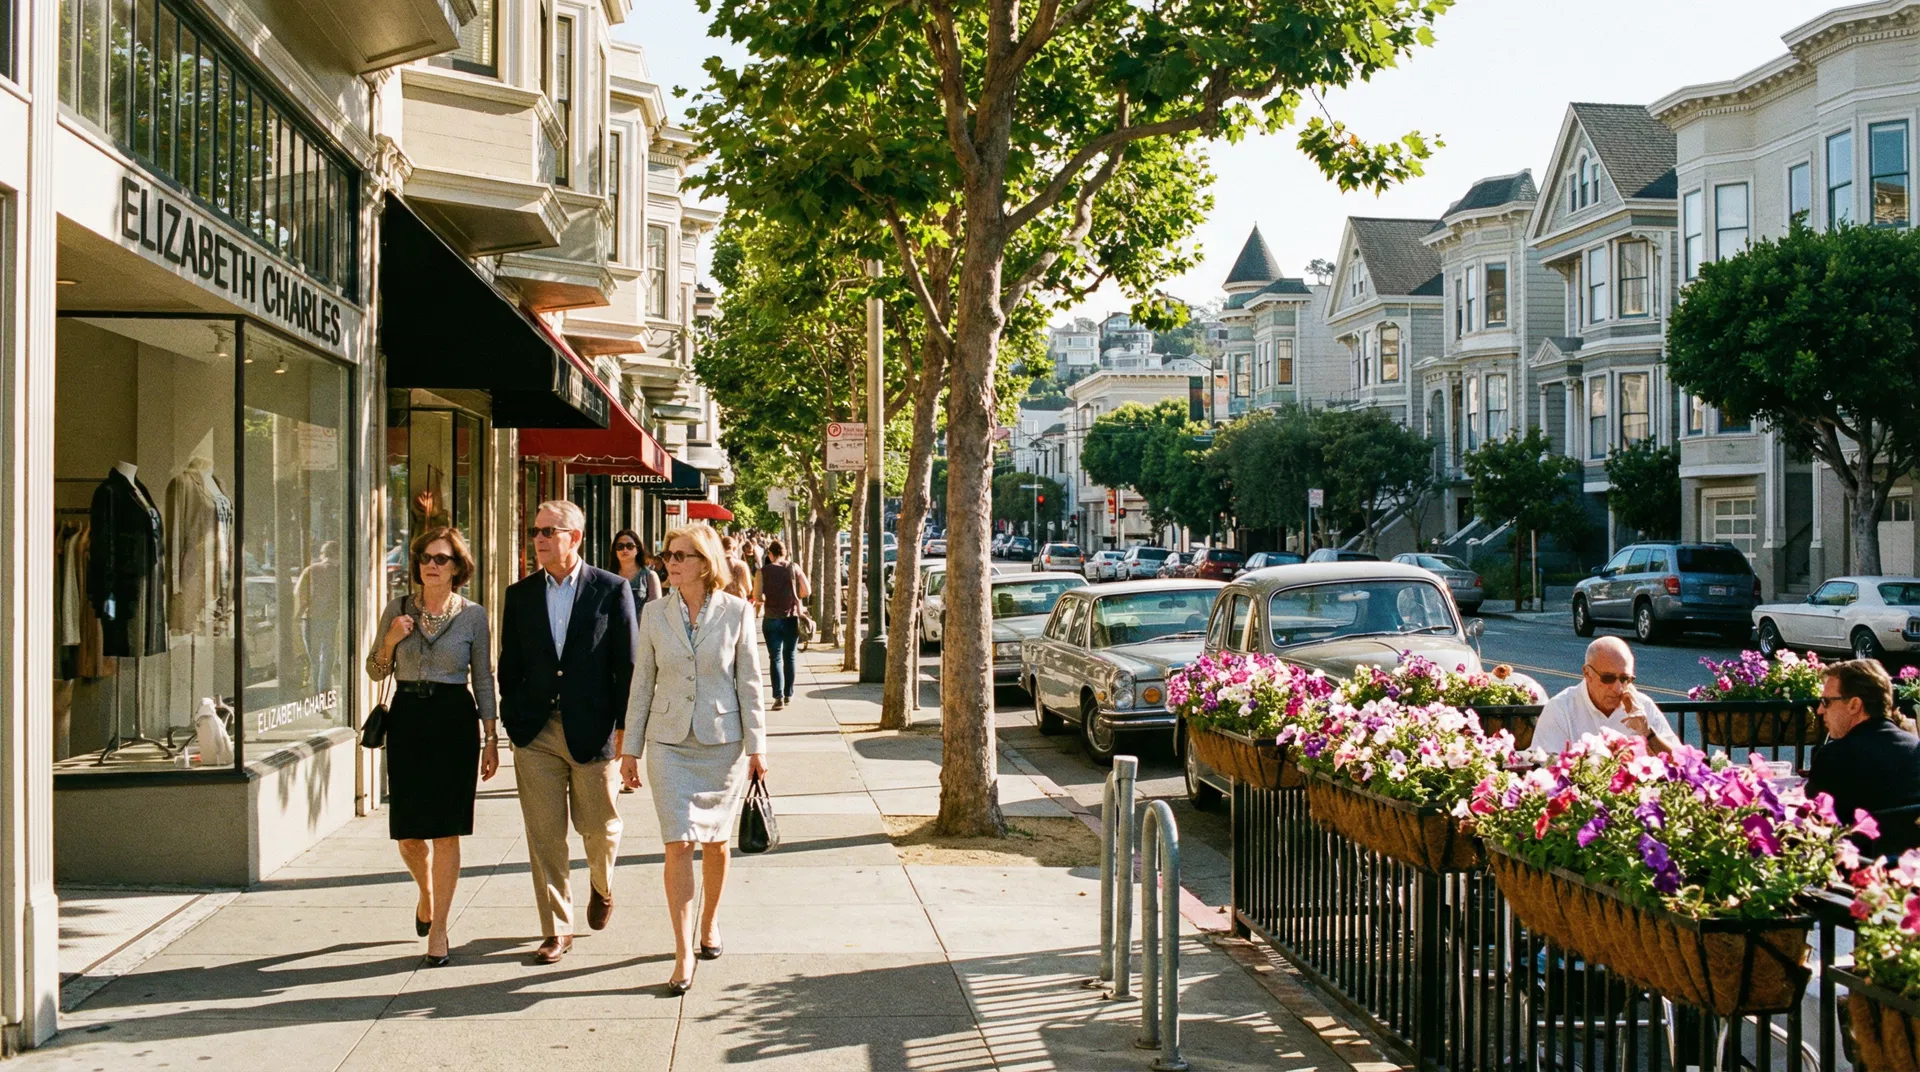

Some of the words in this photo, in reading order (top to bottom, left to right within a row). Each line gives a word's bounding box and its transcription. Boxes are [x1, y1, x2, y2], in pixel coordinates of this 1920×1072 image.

[122, 176, 256, 303] ELIZABETH
[262, 265, 341, 347] CHARLES
[258, 700, 302, 733] ELIZABETH
[304, 690, 337, 716] CHARLES
